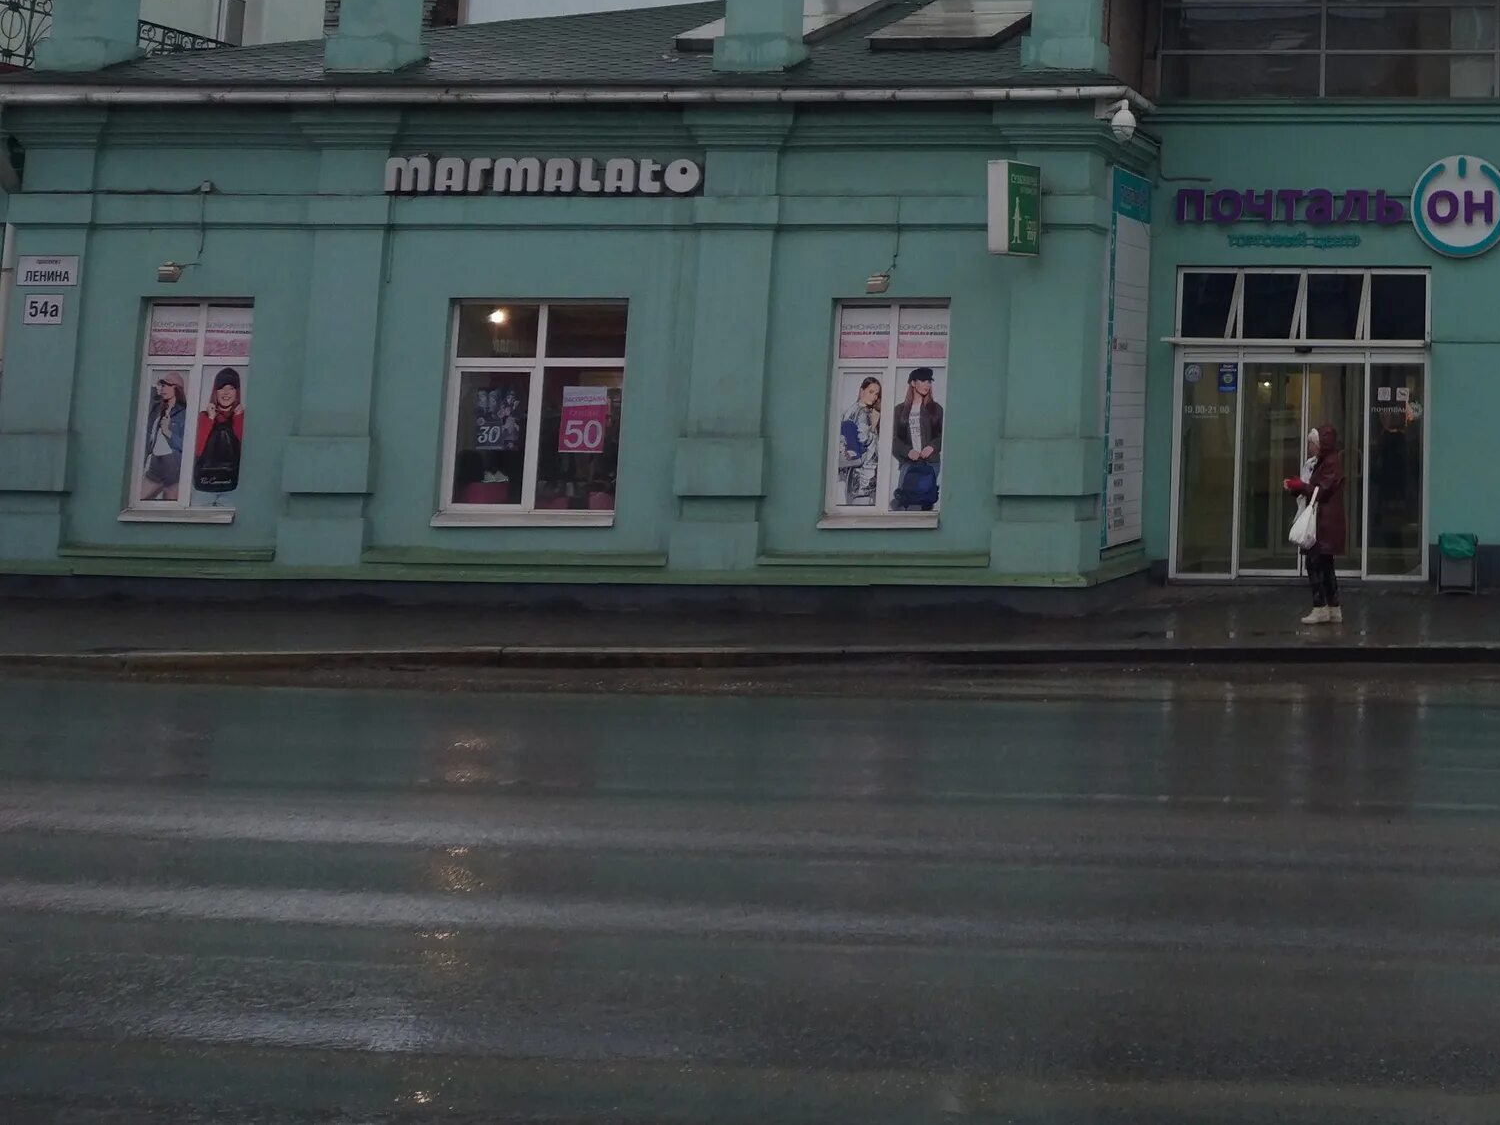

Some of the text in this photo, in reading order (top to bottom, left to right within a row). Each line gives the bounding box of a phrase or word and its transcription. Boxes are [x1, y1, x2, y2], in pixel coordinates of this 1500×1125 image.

[24, 270, 70, 282] ЛЕНИНА
[29, 301, 59, 318] 54а
[477, 426, 501, 443] 30
[564, 420, 602, 448] 50
